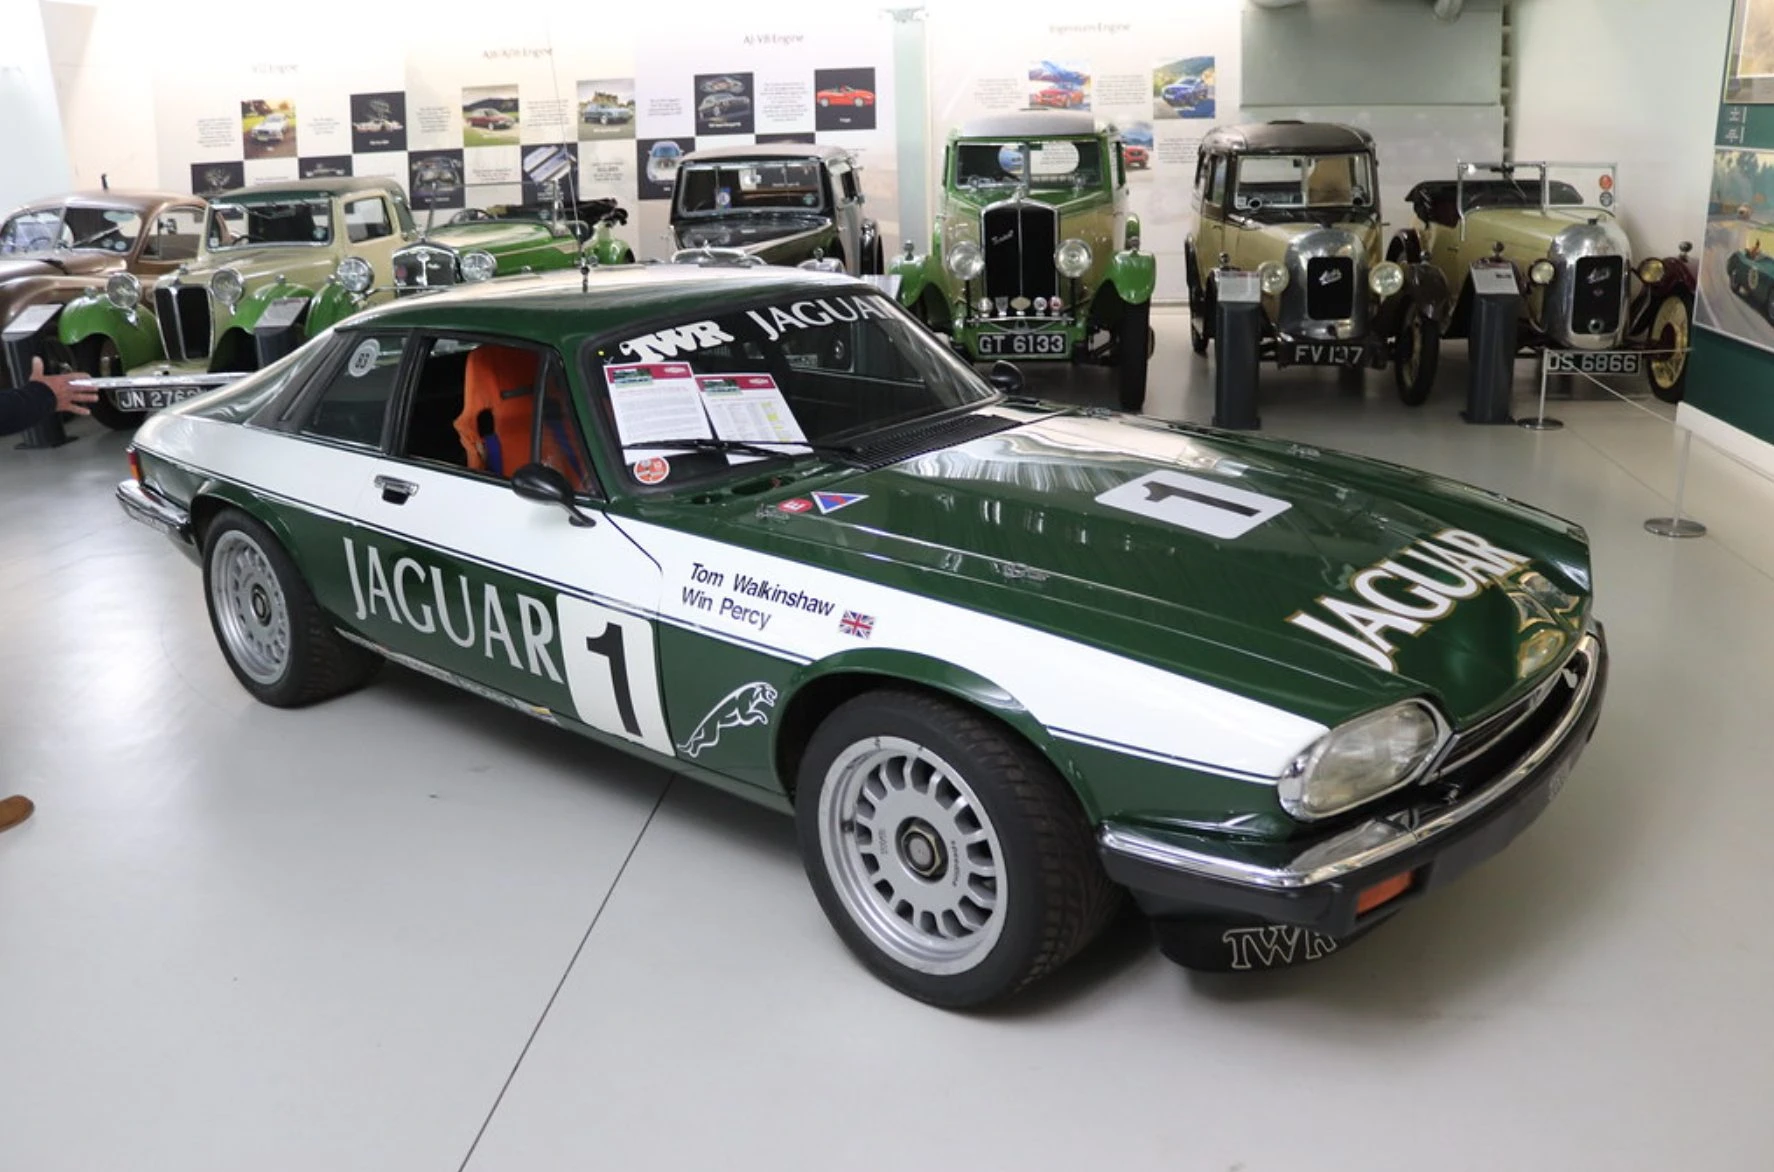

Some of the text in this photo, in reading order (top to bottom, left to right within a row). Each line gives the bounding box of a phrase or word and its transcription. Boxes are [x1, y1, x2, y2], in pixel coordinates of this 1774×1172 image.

[619, 320, 735, 363] TWR
[979, 335, 1064, 353] GT 6133
[1295, 344, 1323, 363] FV
[1581, 353, 1637, 372] 6866
[121, 391, 146, 409] JN
[1142, 479, 1261, 518] 1
[343, 536, 564, 684] JAGUAR
[681, 587, 772, 631] Win Percy
[690, 562, 836, 617] Tom Walkinshaw
[1284, 528, 1535, 674] JAGUAR
[586, 622, 643, 738] 1
